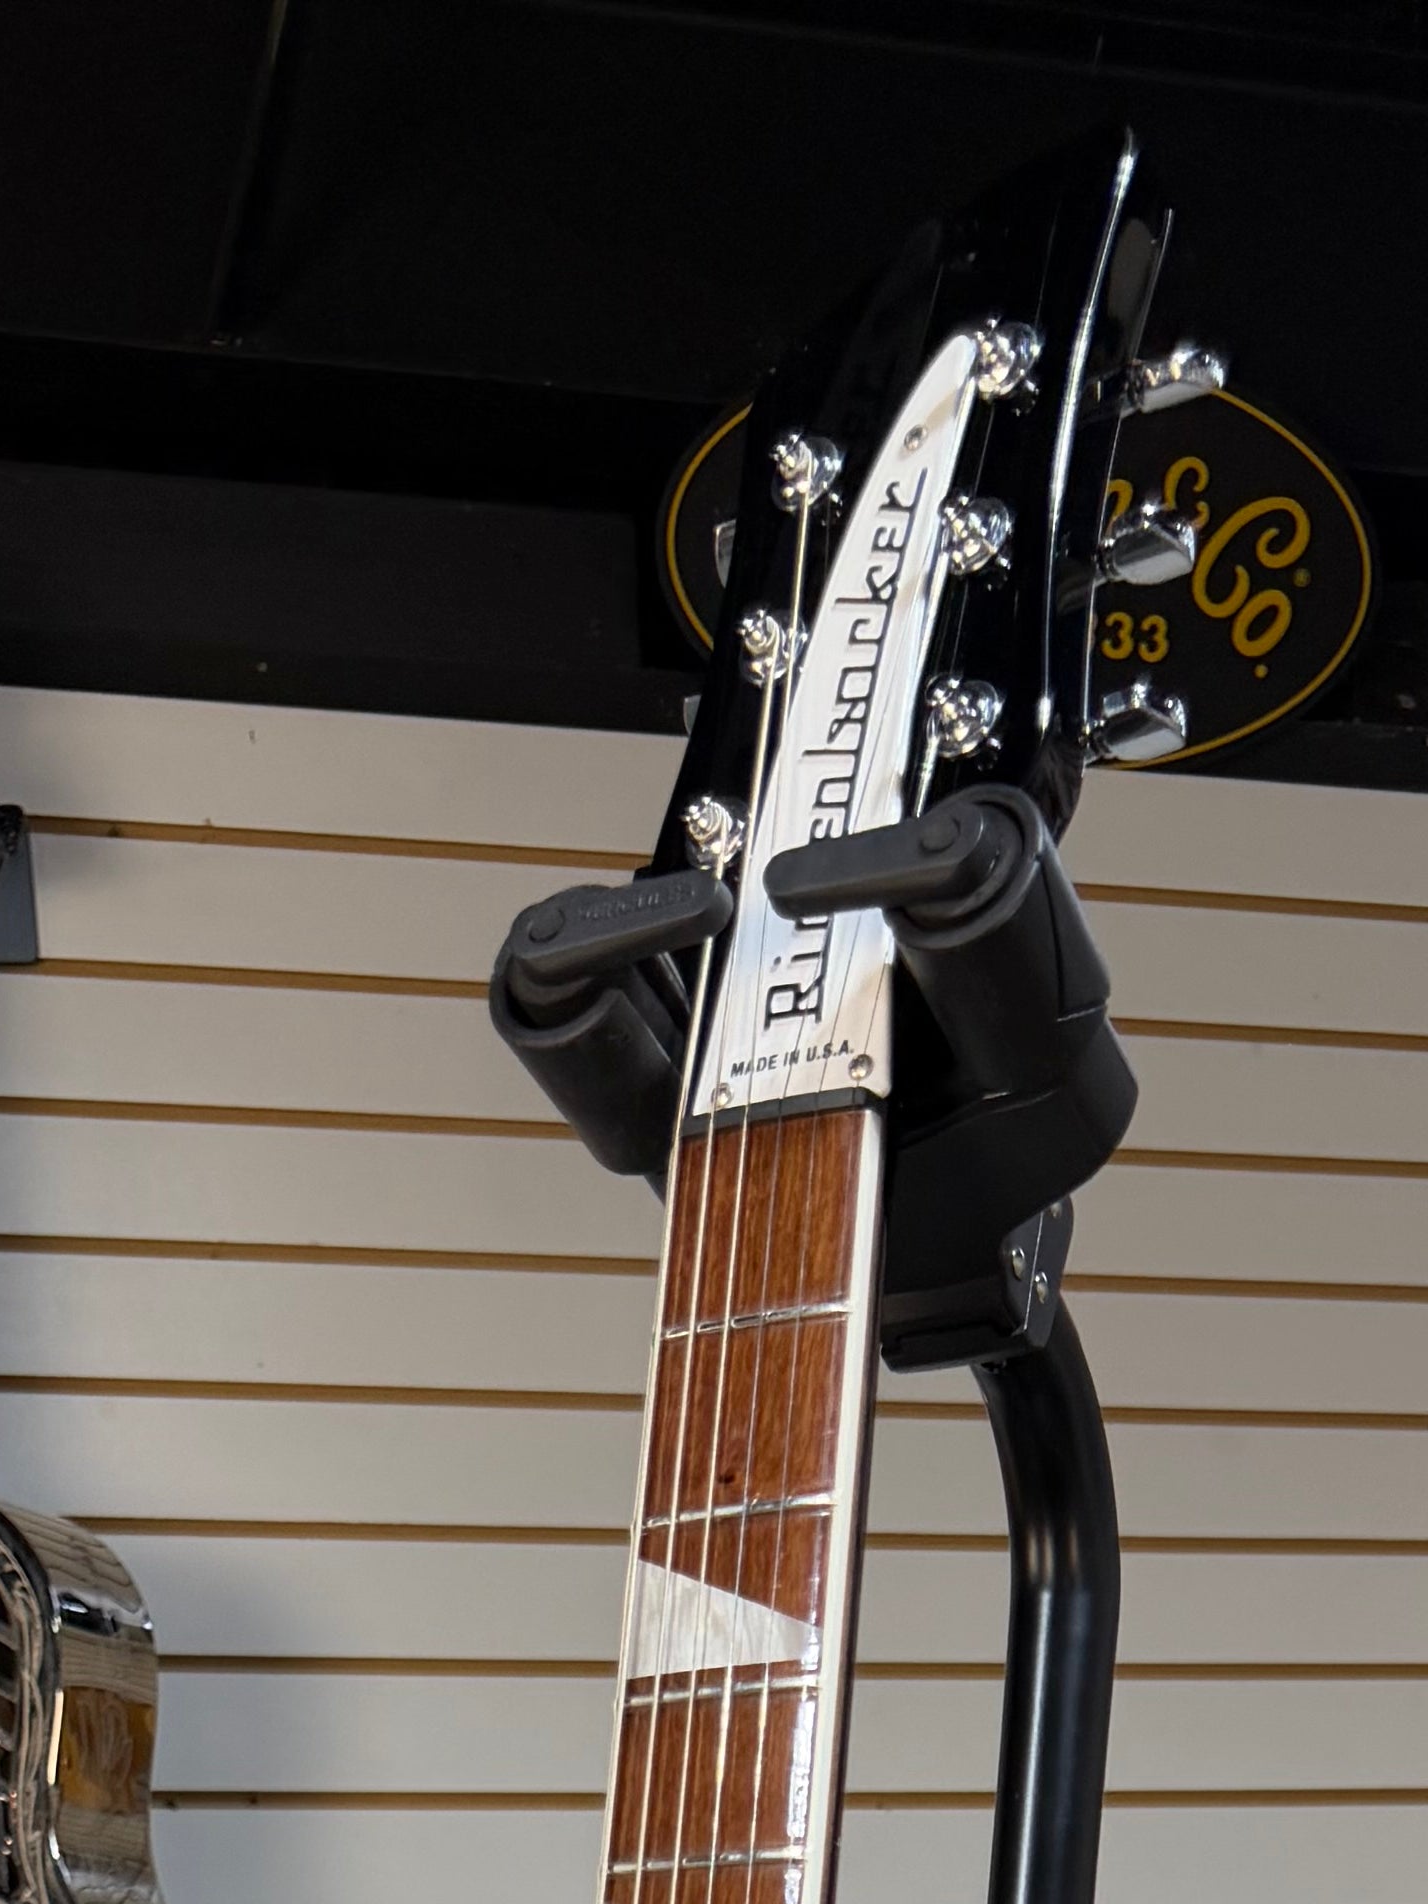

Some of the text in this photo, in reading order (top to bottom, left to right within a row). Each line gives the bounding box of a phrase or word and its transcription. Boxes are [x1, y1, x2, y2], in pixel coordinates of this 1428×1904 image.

[763, 467, 928, 1031] Rienbacker
[730, 1039, 855, 1078] MADE IN U.S.A.
